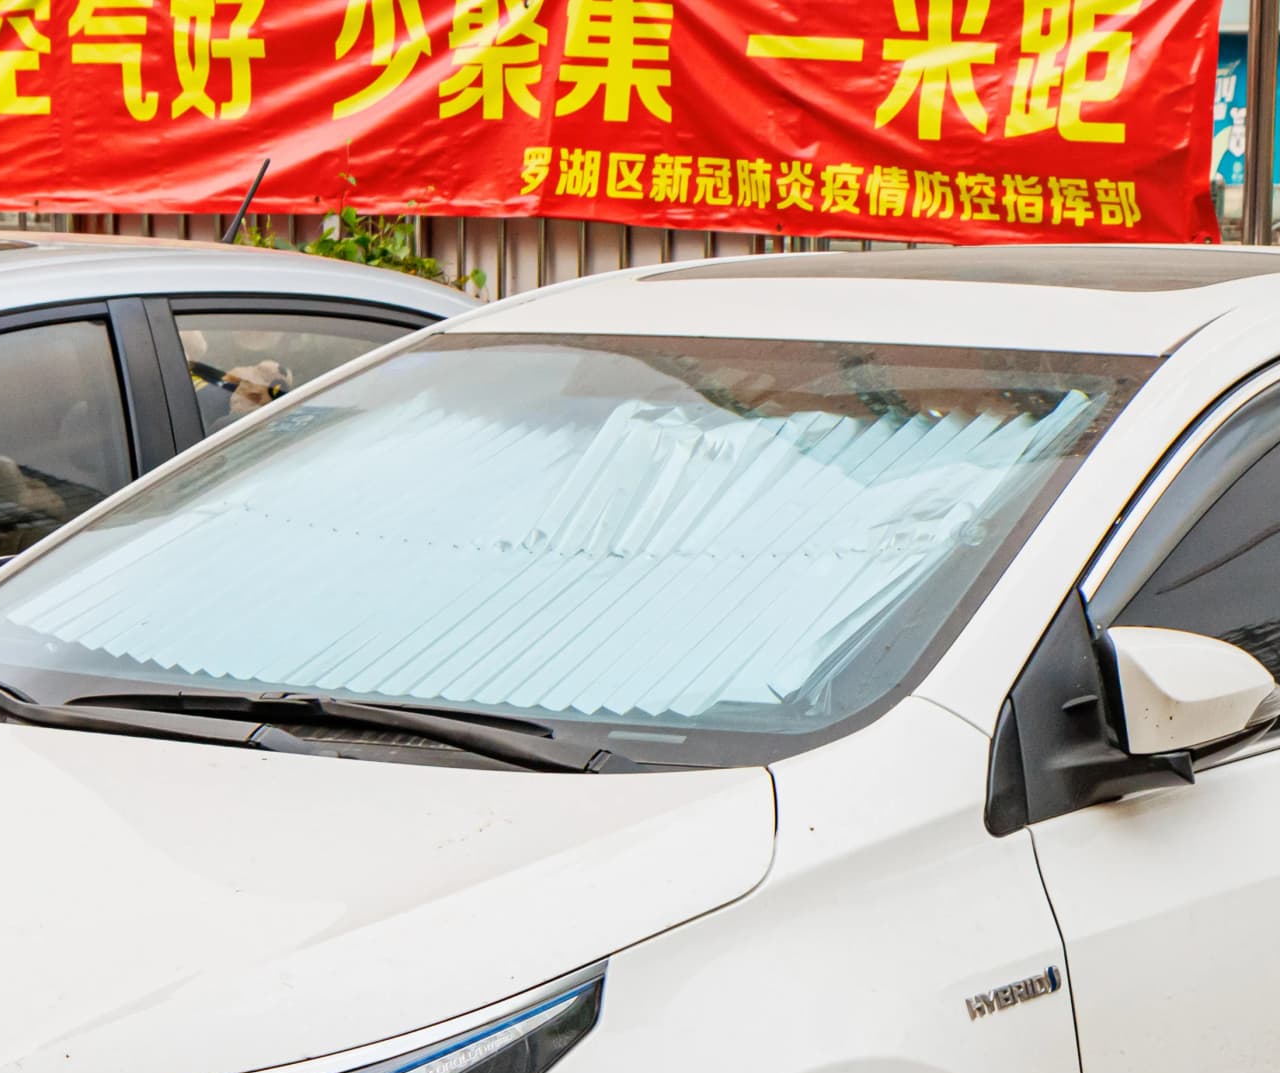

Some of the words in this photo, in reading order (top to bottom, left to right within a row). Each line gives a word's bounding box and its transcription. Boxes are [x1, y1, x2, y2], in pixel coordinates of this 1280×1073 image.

[332, 0, 673, 122] 少聚集
[746, 0, 1142, 143] 一米距
[520, 146, 1142, 228] 罗湖区新冠肺炎疫情防控指挥部
[964, 973, 1050, 1021] HYBRID
